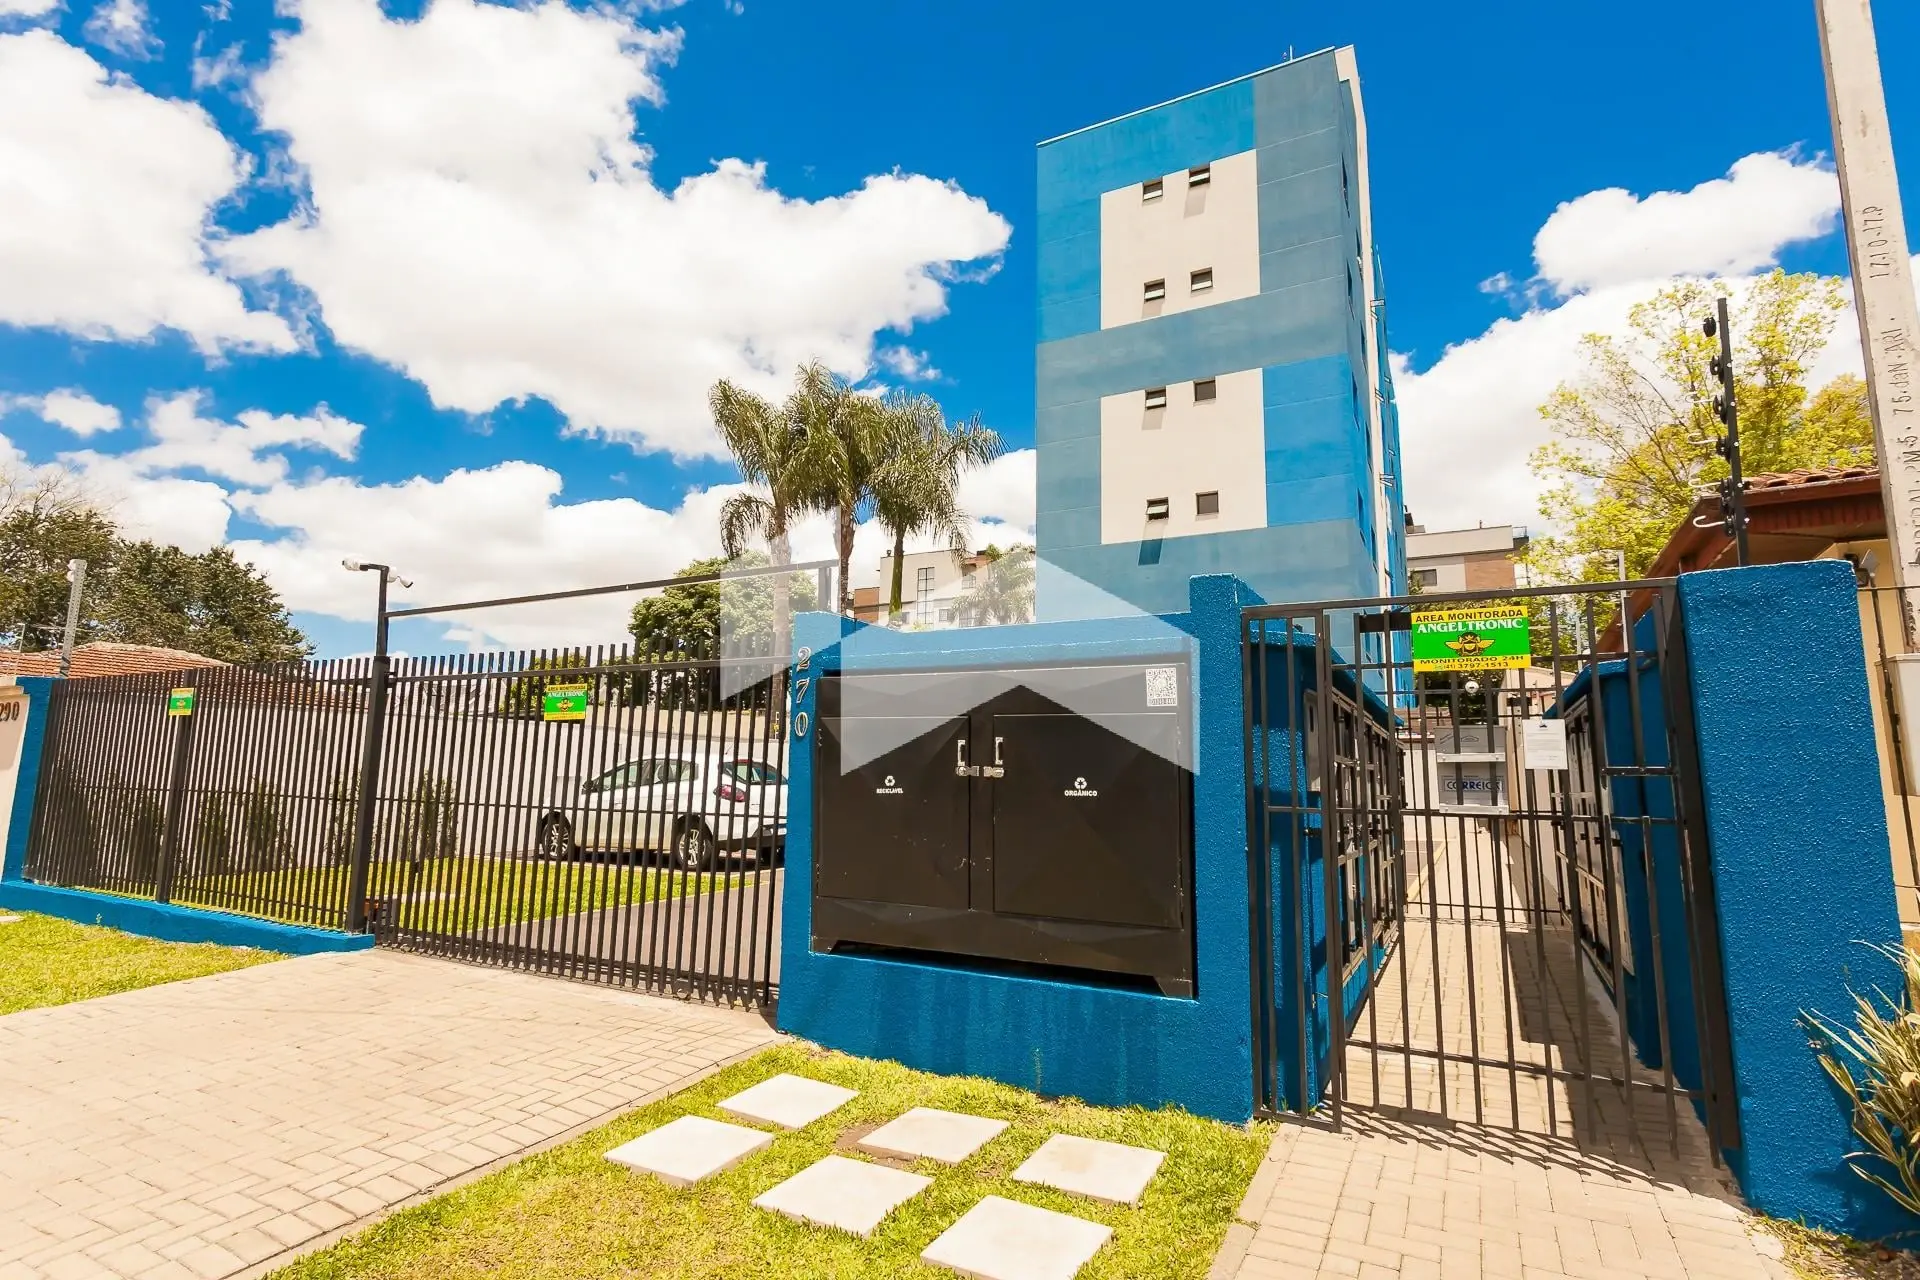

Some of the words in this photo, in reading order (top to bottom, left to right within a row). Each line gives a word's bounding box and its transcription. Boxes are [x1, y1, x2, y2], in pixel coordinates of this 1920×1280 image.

[1448, 609, 1523, 620] MONITORADA
[1417, 619, 1523, 633] ANGELTRONIC
[1420, 656, 1498, 665] MONITORADO
[1457, 661, 1509, 669] 3797-1513
[794, 646, 812, 737] 270
